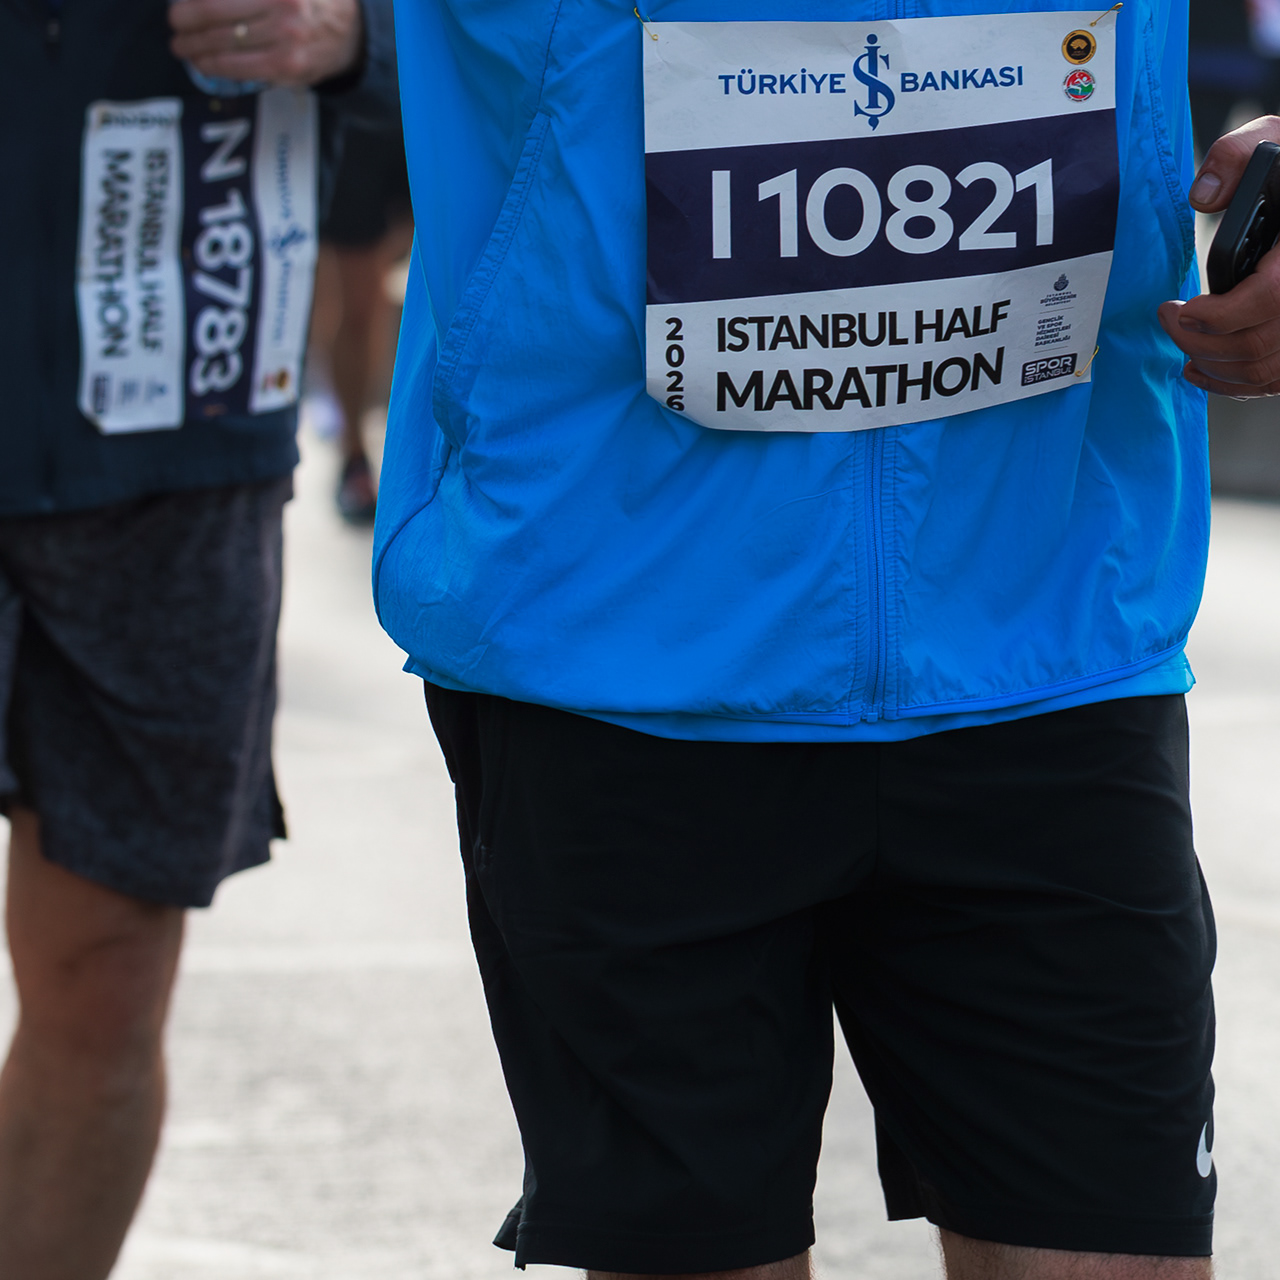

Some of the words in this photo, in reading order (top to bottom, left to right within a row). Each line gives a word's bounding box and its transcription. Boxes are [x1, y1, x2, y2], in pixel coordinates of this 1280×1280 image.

[718, 68, 846, 95] TÜRKİYE
[900, 66, 1023, 93] BANKASI
[200, 120, 251, 183] N
[711, 169, 732, 260] I
[757, 157, 1055, 259] 10821
[95, 148, 133, 358] MARATHON
[190, 188, 255, 397] 18783
[717, 311, 909, 352] ISTANBUL
[915, 299, 1011, 344] HALF
[665, 317, 686, 412] 2026
[716, 346, 1006, 412] MARATHON
[1024, 356, 1073, 376] SPOR
